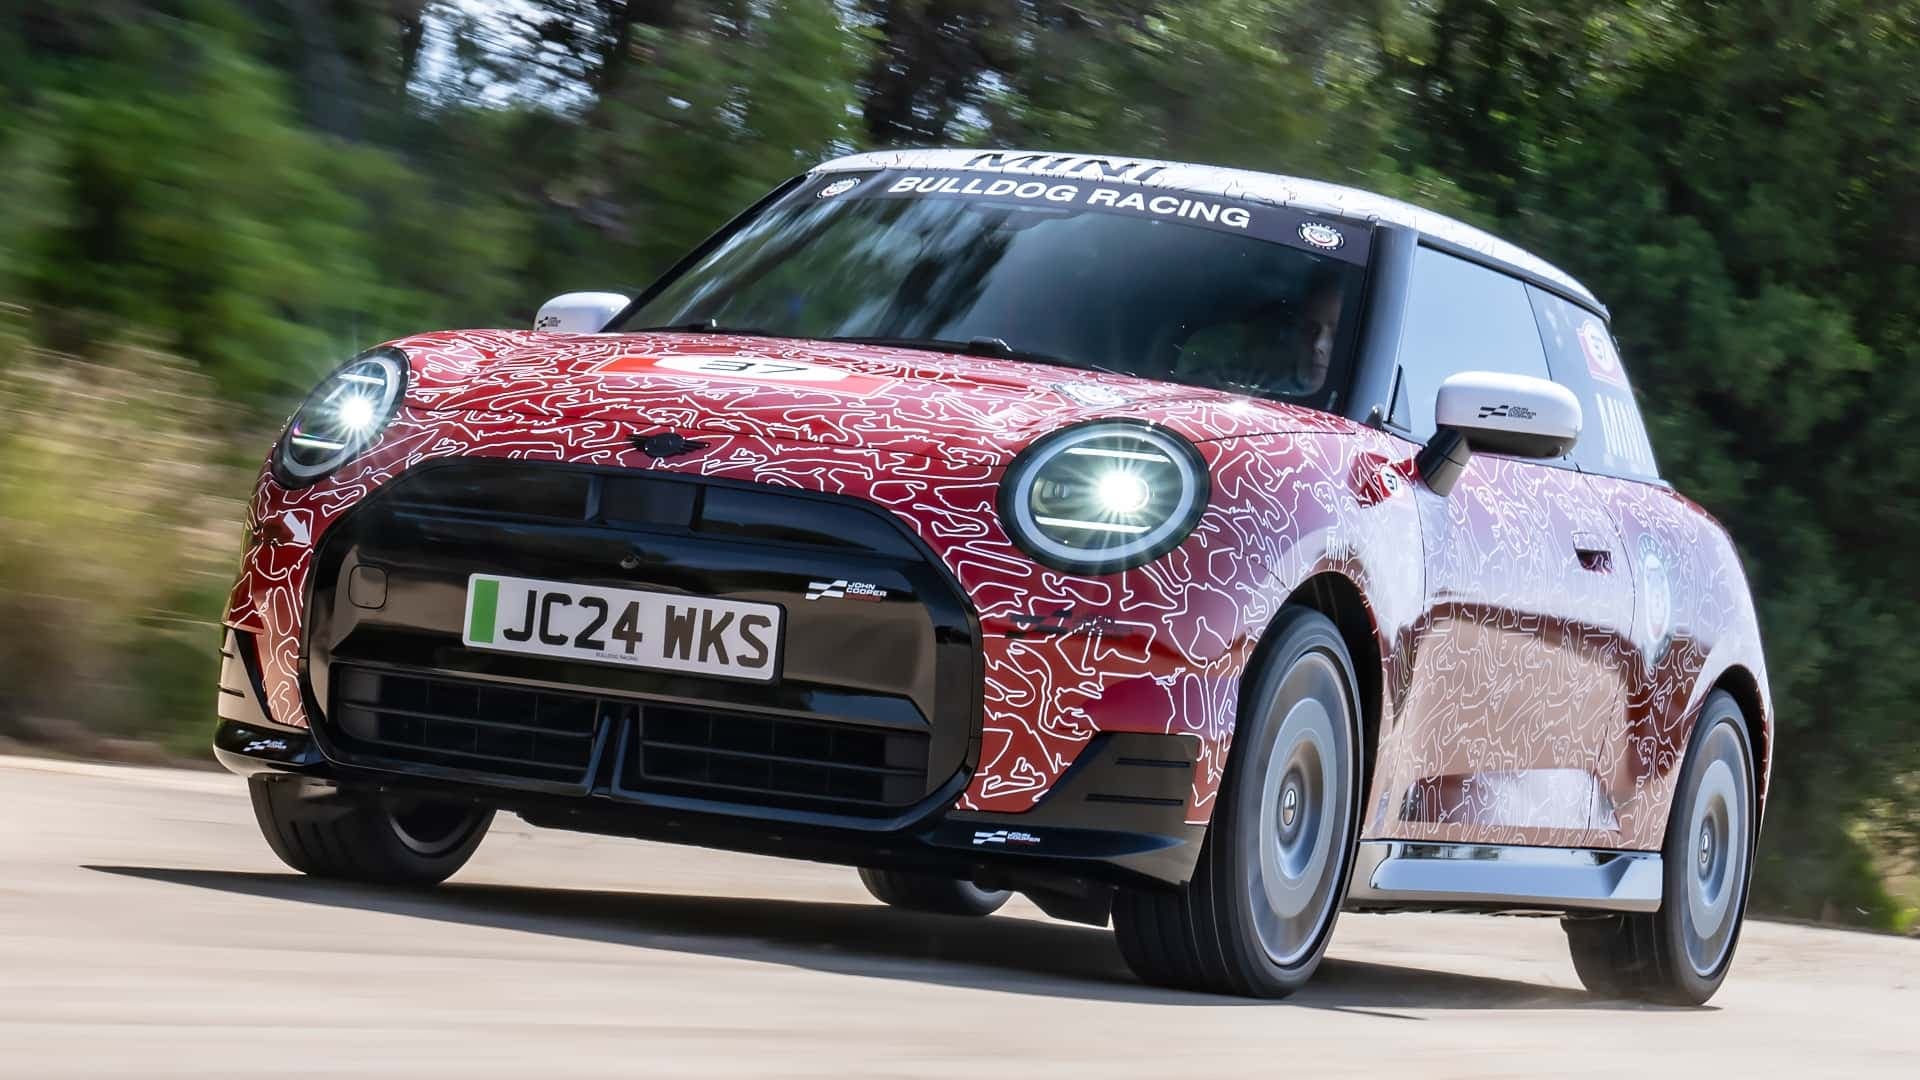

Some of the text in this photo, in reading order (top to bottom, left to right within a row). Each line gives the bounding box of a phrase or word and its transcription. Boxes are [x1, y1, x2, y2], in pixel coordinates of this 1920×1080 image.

[963, 153, 1168, 182] MINI
[887, 176, 1076, 203] BULLDOG
[1086, 186, 1252, 229] RACING
[698, 359, 808, 374] 37
[845, 587, 888, 598] COOPER
[847, 582, 876, 590] JOHN
[502, 589, 773, 669] JC24 WKS
